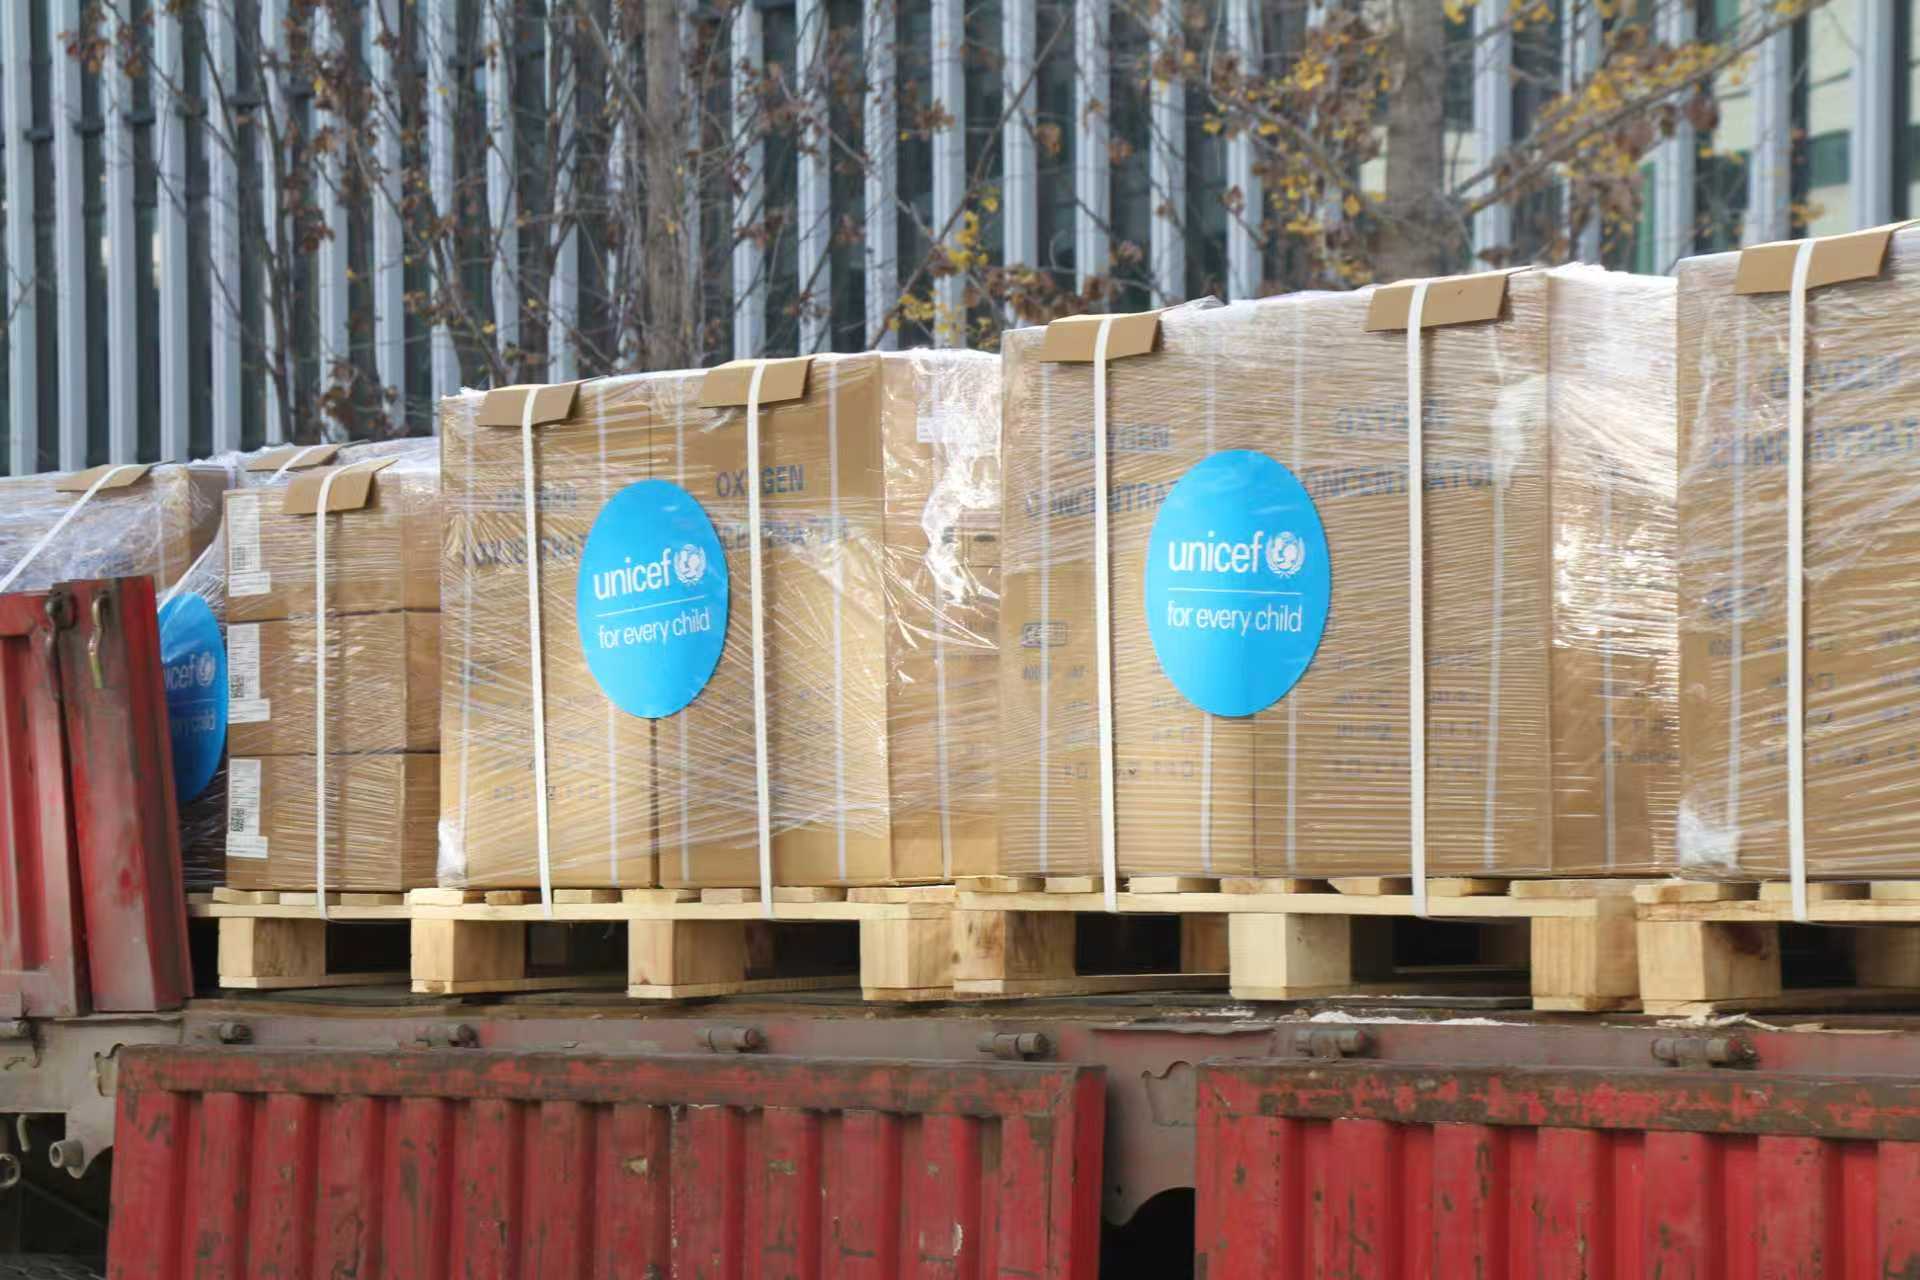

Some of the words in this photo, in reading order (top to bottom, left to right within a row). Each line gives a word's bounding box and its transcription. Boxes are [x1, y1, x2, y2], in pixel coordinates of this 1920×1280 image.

[715, 464, 805, 498] OXGEN
[1168, 530, 1264, 573] unicef
[593, 548, 671, 600] unicef
[598, 625, 621, 649] for
[623, 619, 670, 646] every
[672, 607, 711, 637] child
[1167, 600, 1193, 628] for
[1196, 606, 1251, 637] every
[1255, 603, 1303, 633] child
